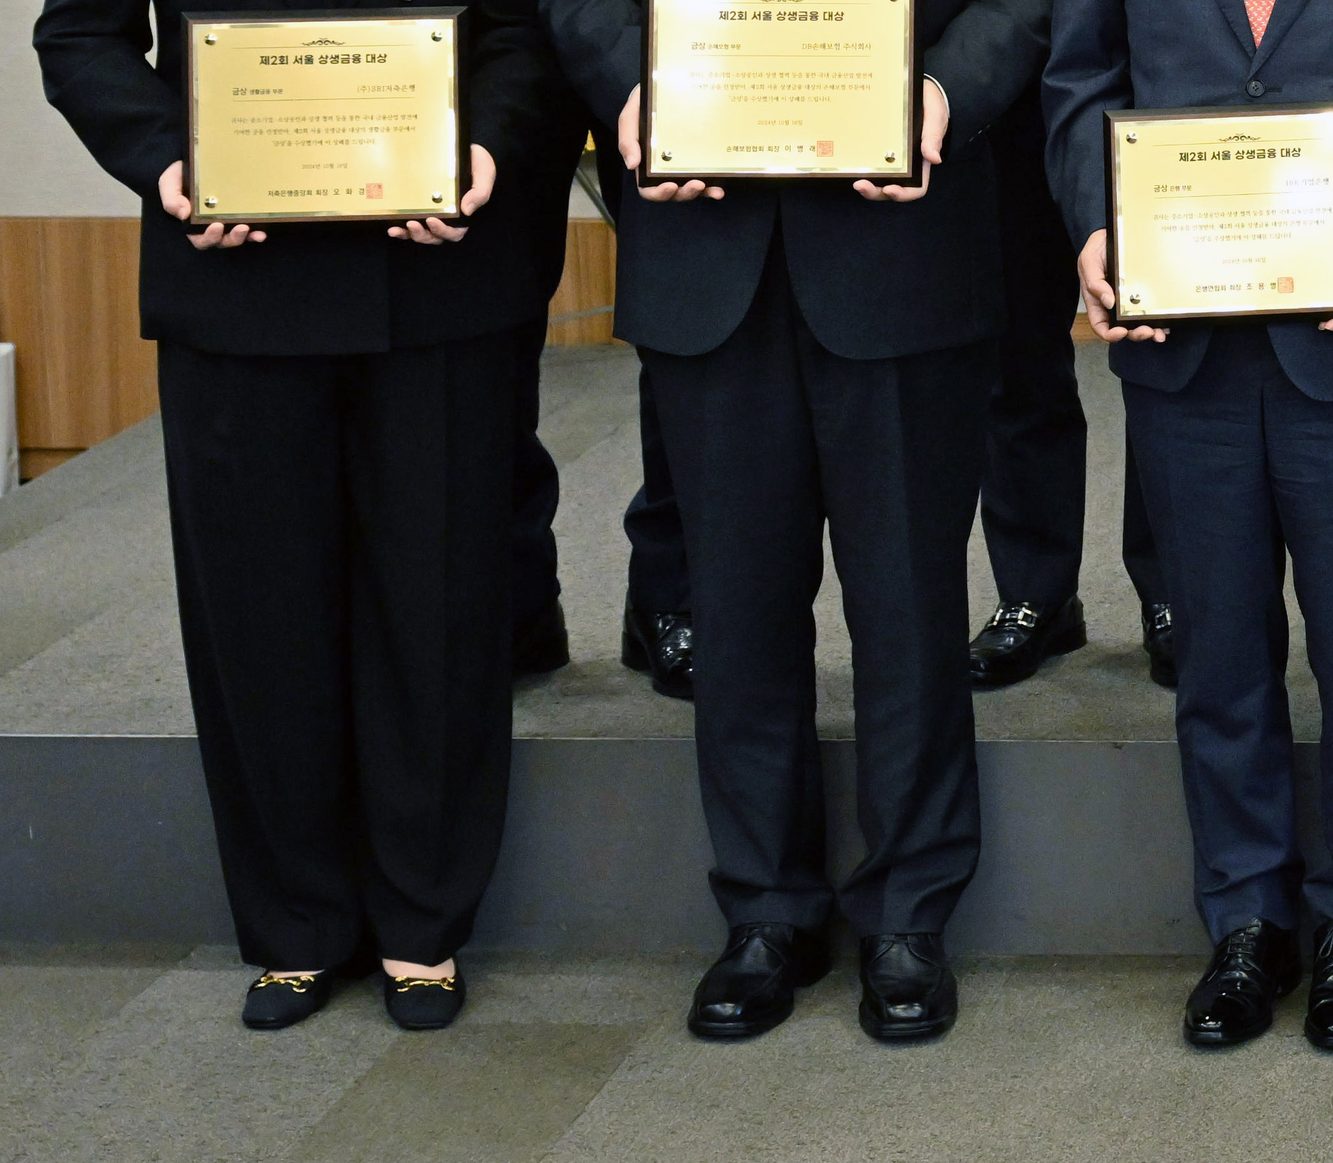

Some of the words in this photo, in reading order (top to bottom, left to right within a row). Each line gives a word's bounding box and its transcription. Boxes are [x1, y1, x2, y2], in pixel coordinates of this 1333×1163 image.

[719, 11, 747, 21] 제2회
[751, 11, 772, 21] 서울
[776, 11, 819, 21] 상생금융
[823, 11, 844, 21] 대상
[691, 42, 706, 50] 금상
[843, 43, 871, 51] 주식회사
[260, 55, 288, 65] 제2회
[293, 54, 314, 65] 서울
[318, 54, 361, 64] 상생금융
[366, 53, 387, 63] 대상
[1179, 152, 1207, 162] 제2회
[1211, 150, 1230, 161] 서울
[1235, 149, 1277, 159] 상생금융
[1281, 148, 1301, 158] 대상
[1153, 184, 1167, 192] 금상
